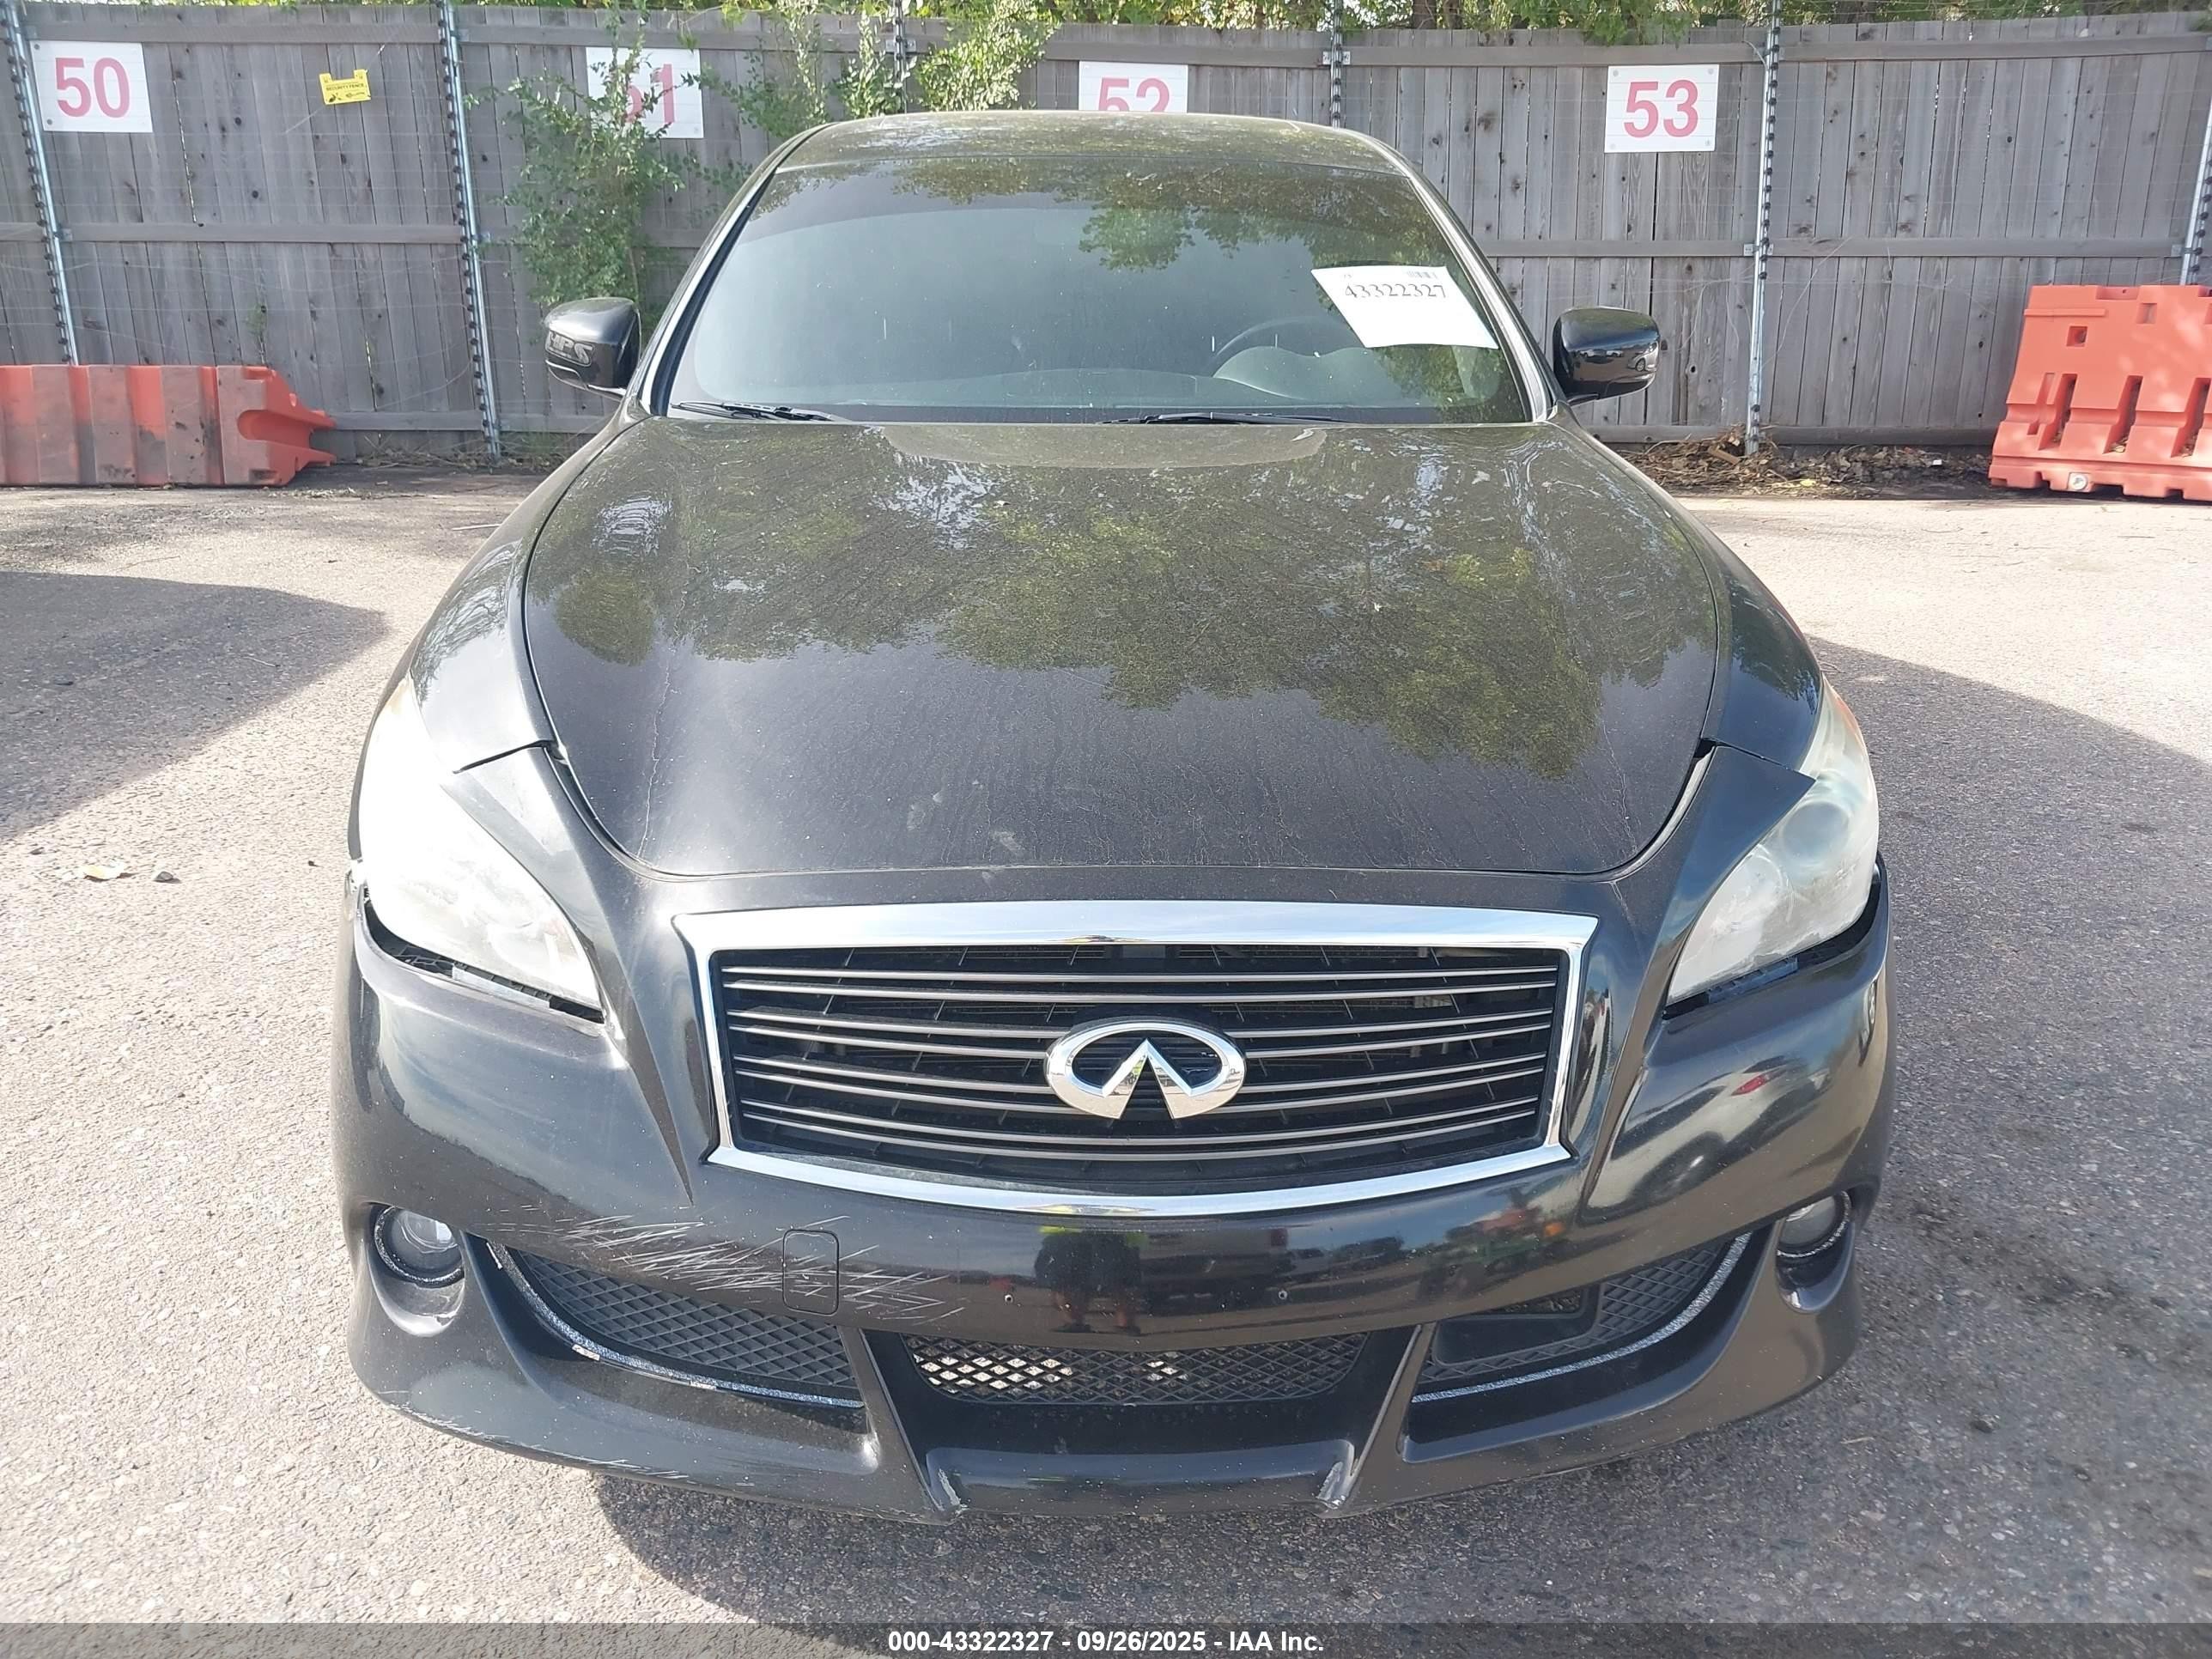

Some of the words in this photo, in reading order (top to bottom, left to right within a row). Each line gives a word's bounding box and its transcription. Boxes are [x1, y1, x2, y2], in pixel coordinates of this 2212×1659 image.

[54, 57, 130, 118] 50
[1623, 79, 1699, 138] 53
[1345, 283, 1446, 299] 43322327
